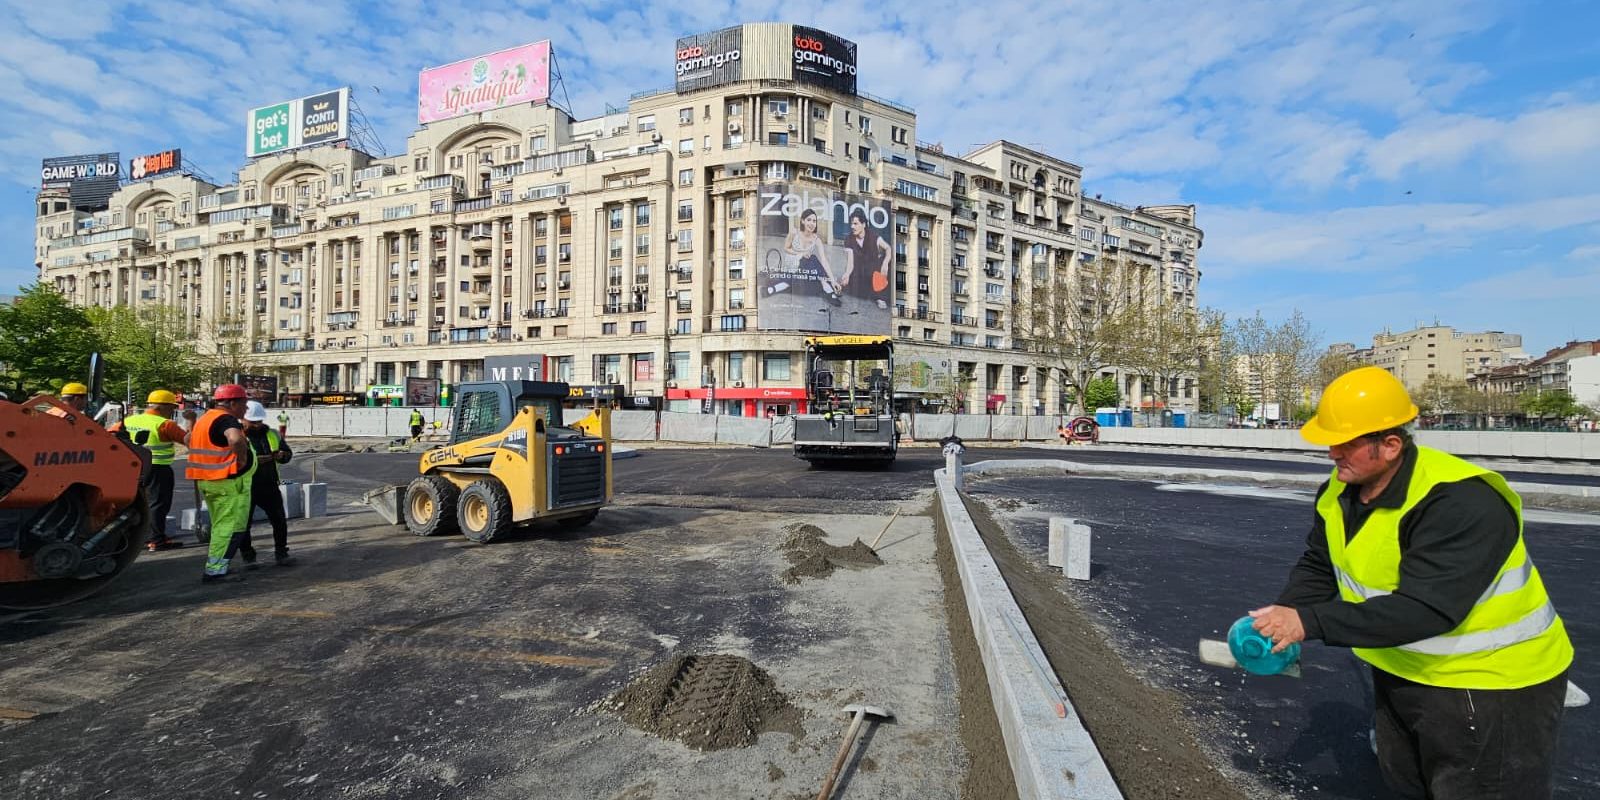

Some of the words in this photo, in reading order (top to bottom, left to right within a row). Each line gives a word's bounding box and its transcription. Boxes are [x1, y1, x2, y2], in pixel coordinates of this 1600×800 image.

[794, 36, 823, 51] toto
[677, 46, 702, 60] toto
[676, 49, 740, 75] gaming.ro
[794, 49, 857, 76] gaming.ro
[438, 80, 523, 114] Aquatique
[256, 110, 288, 134] get's
[305, 110, 335, 125] CONTI
[303, 121, 338, 138] CAZINO
[260, 131, 283, 149] bet
[145, 155, 160, 173] Help
[160, 151, 174, 169] Net
[41, 165, 75, 180] GAME
[76, 163, 117, 177] WORLD
[760, 190, 889, 229] zalando
[33, 450, 95, 466] HAMM
[429, 448, 460, 464] GEHL
